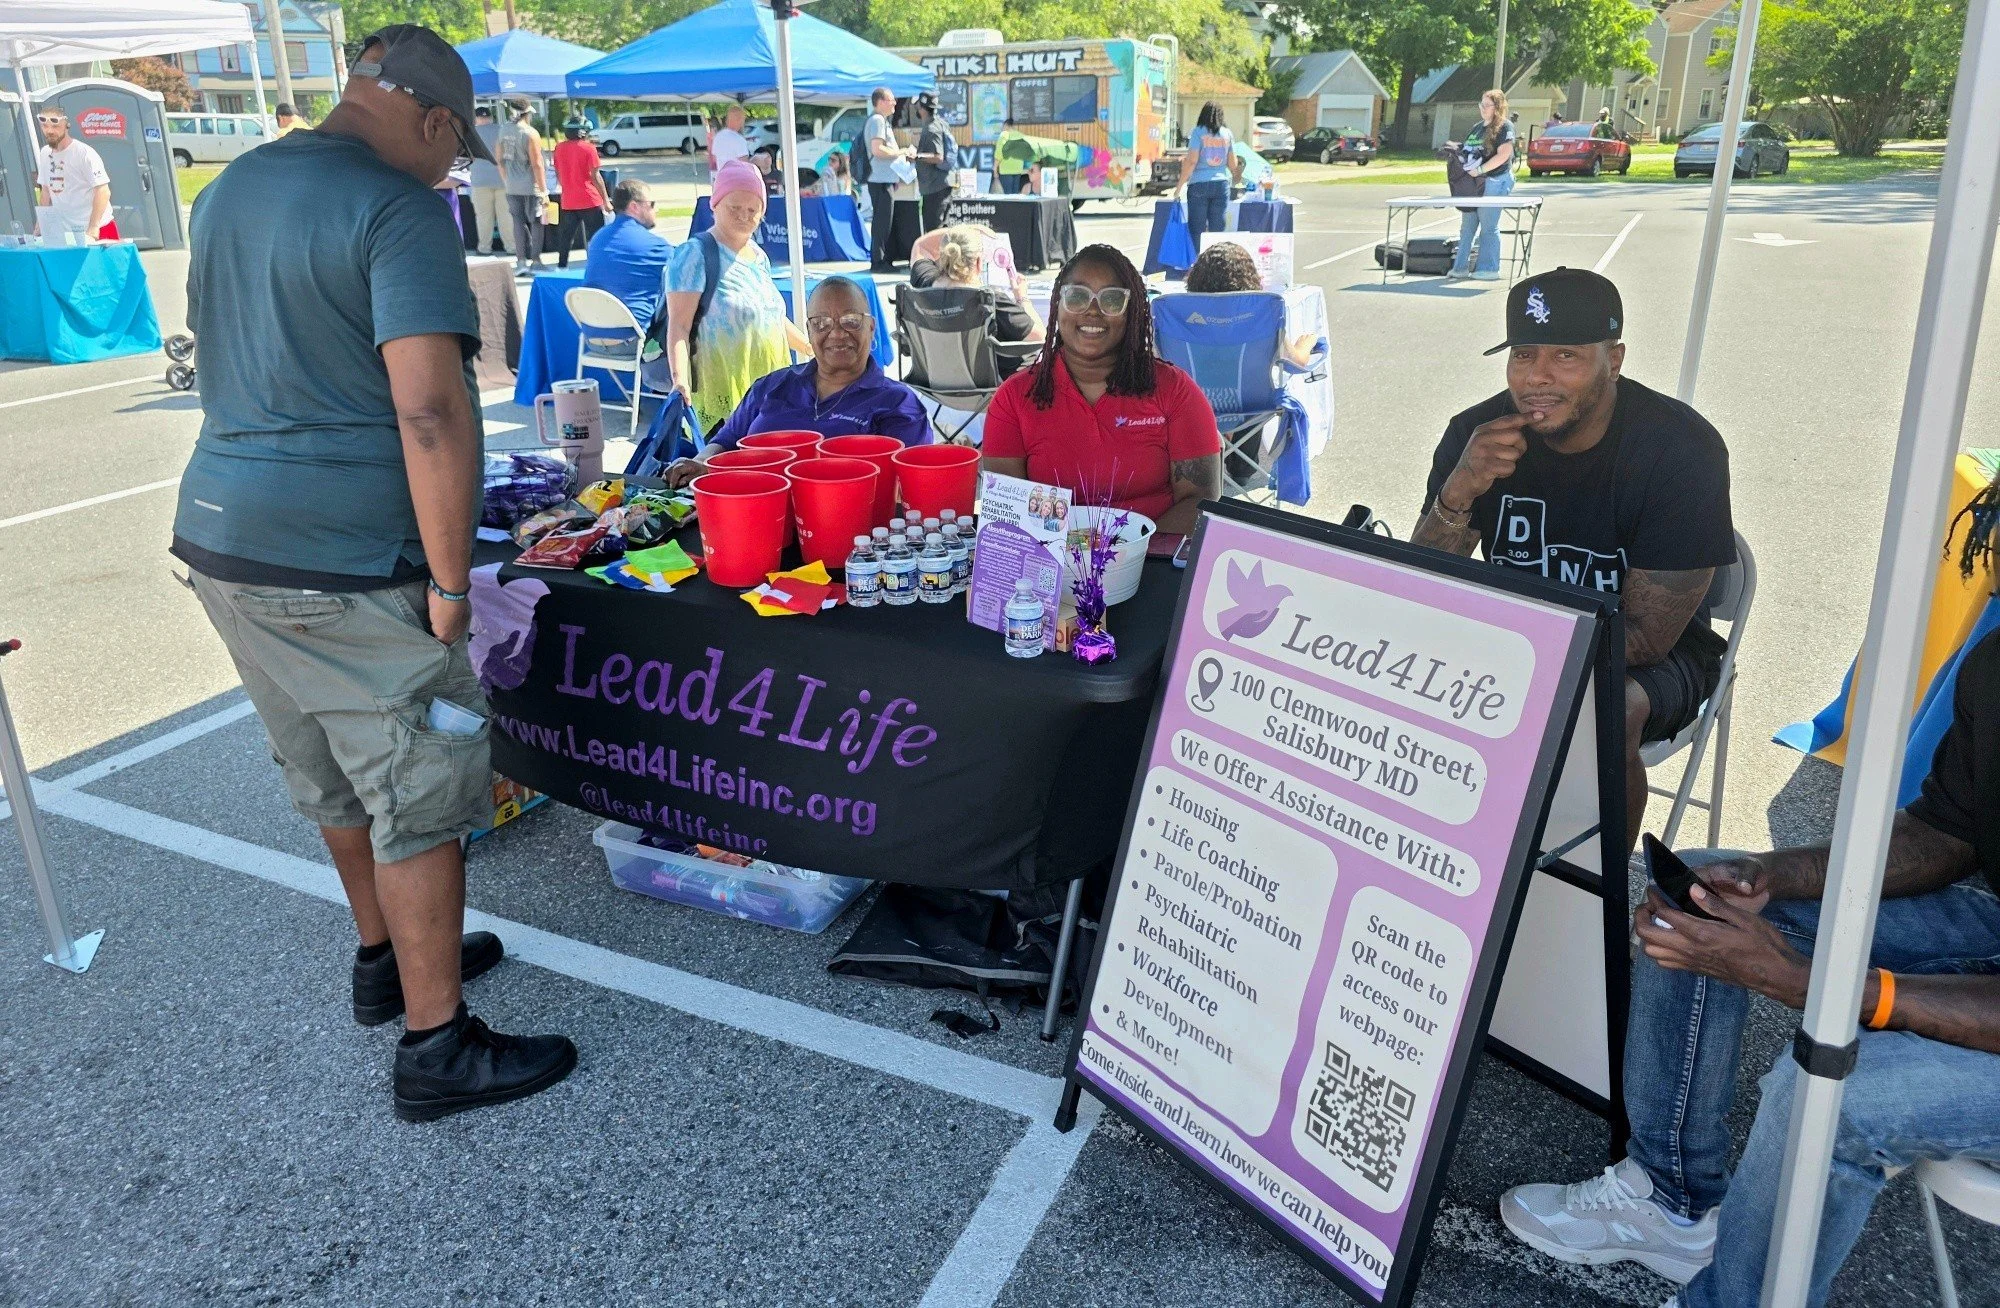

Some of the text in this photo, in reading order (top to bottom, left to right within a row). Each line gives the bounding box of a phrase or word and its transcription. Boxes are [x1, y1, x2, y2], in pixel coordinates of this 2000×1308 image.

[921, 49, 1083, 76] TIKI HUT
[1015, 78, 1047, 88] COFFEE
[962, 202, 996, 214] Brothers
[1128, 416, 1166, 426] Lead4Life
[982, 505, 1021, 520] REHABILITATION
[983, 499, 1013, 511] PSYCHIATRIC
[1508, 515, 1530, 542] D
[1508, 549, 1529, 559] 3.00
[1550, 548, 1558, 556] 9
[1560, 560, 1580, 584] N
[1595, 569, 1619, 592] H
[555, 623, 938, 775] Lead4Life
[1281, 614, 1505, 720] Lead4Life
[1230, 671, 1477, 793] 100 Clemwood Street,
[1262, 715, 1419, 797] Salisbury MD
[500, 714, 877, 836] www.Lead4Lifeinc.org
[579, 781, 768, 853] @lead4lifeinc
[1168, 787, 1239, 843] Housing
[1179, 735, 1466, 888] We Offer Assistance With:
[1160, 820, 1280, 903] Life Coaching
[1145, 883, 1238, 954] Psychiatric
[1153, 852, 1303, 951] Parole/Probation
[1137, 915, 1258, 1004] Rehabilitation
[1351, 940, 1448, 1005] QR code to
[1367, 915, 1446, 969] Scan the
[1133, 946, 1218, 1017] Workforce
[1342, 973, 1438, 1037] access our
[1116, 1010, 1180, 1066] & More!
[1123, 977, 1234, 1065] Development
[1339, 1004, 1424, 1066] webpage:
[1080, 1038, 1388, 1282] Come inside and learn how we can help you
